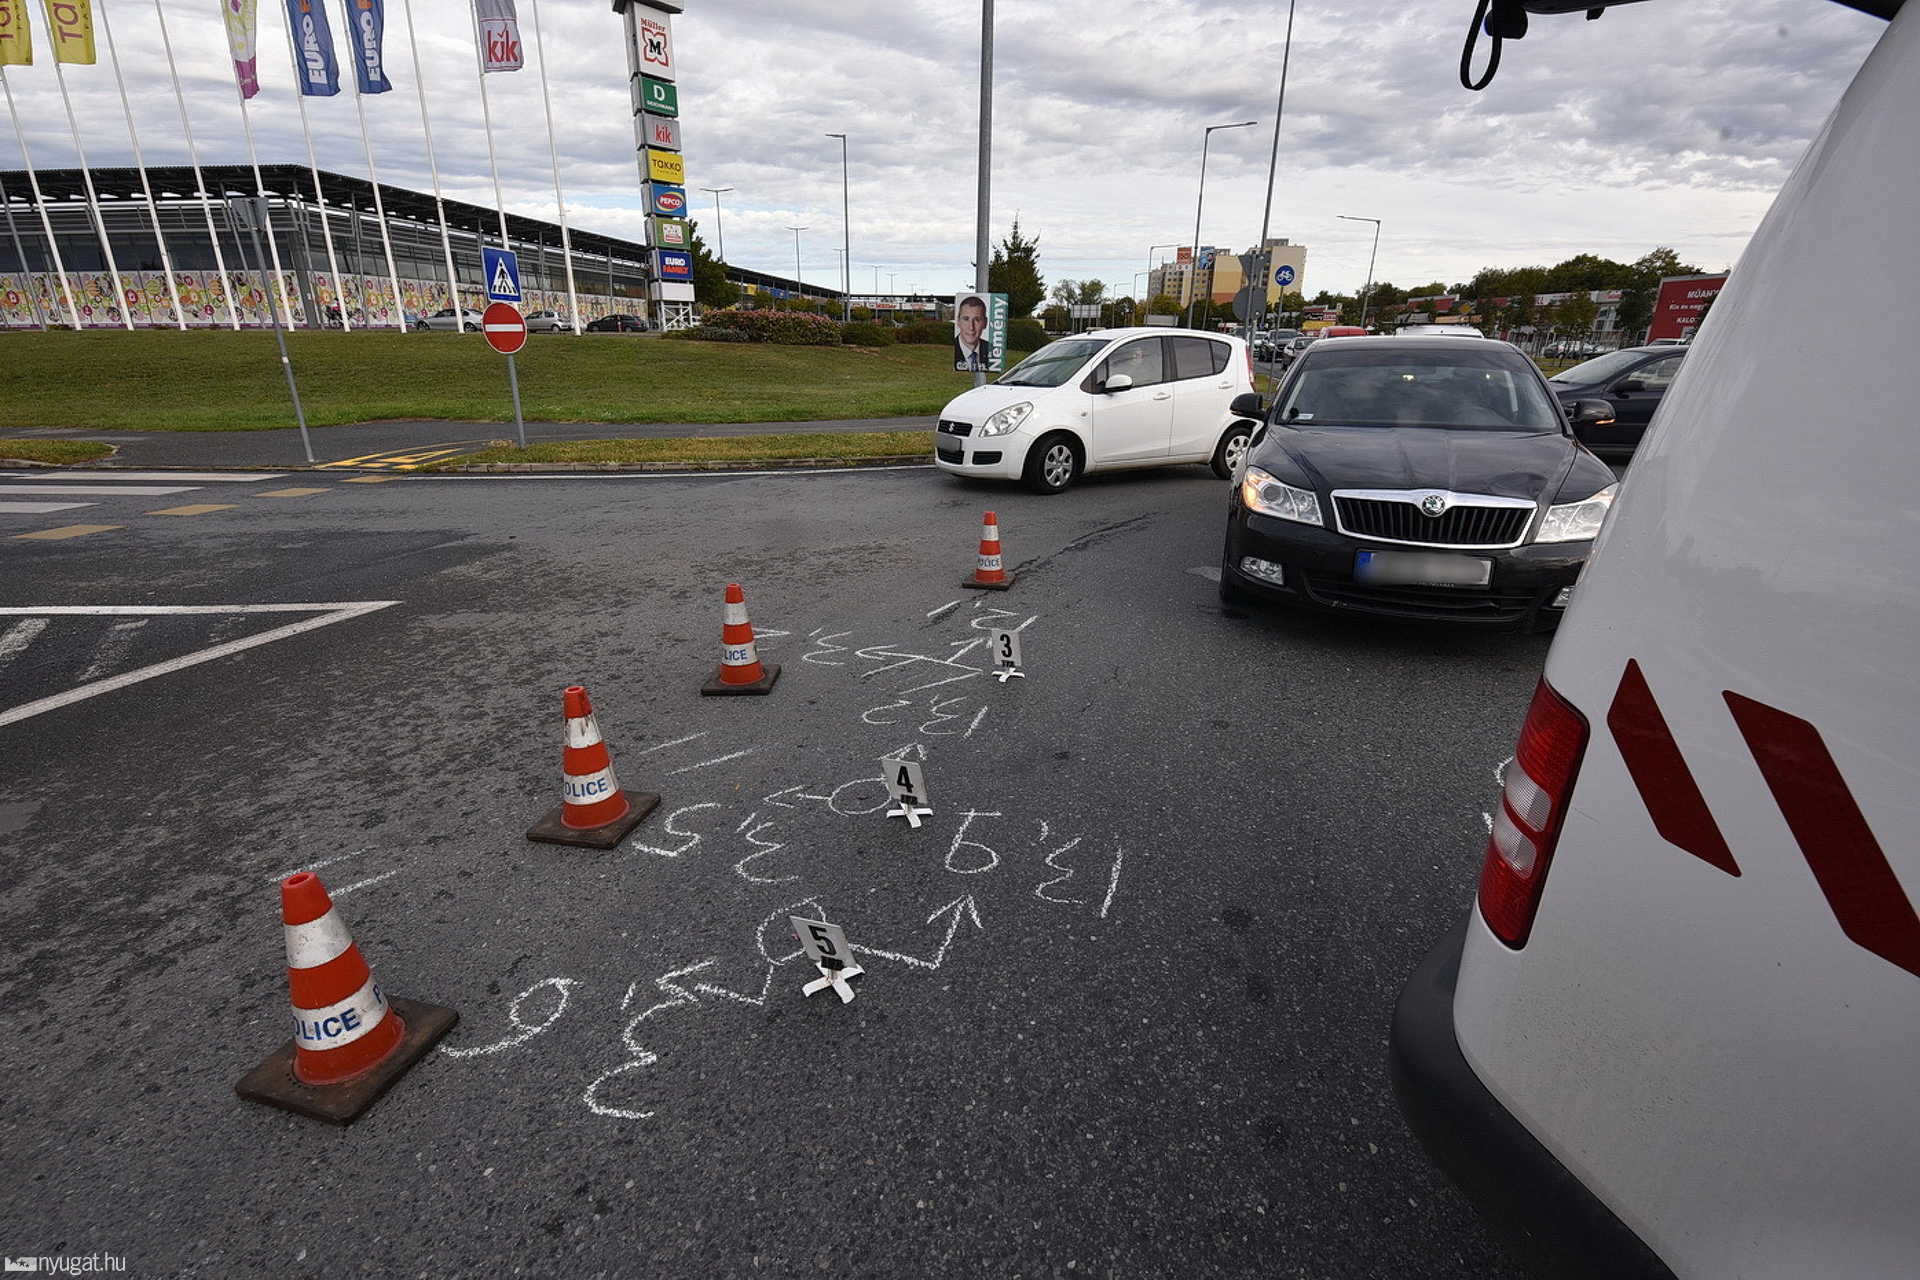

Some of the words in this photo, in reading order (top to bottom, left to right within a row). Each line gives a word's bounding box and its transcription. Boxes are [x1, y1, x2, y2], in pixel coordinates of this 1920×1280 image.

[303, 14, 328, 84] EURO
[360, 11, 381, 81] EURO
[487, 23, 519, 63] kik
[653, 84, 666, 102] D
[655, 125, 672, 143] kik
[1000, 634, 1012, 658] 3
[565, 778, 609, 797] OLICE
[897, 766, 914, 793] 4
[808, 925, 837, 956] 5
